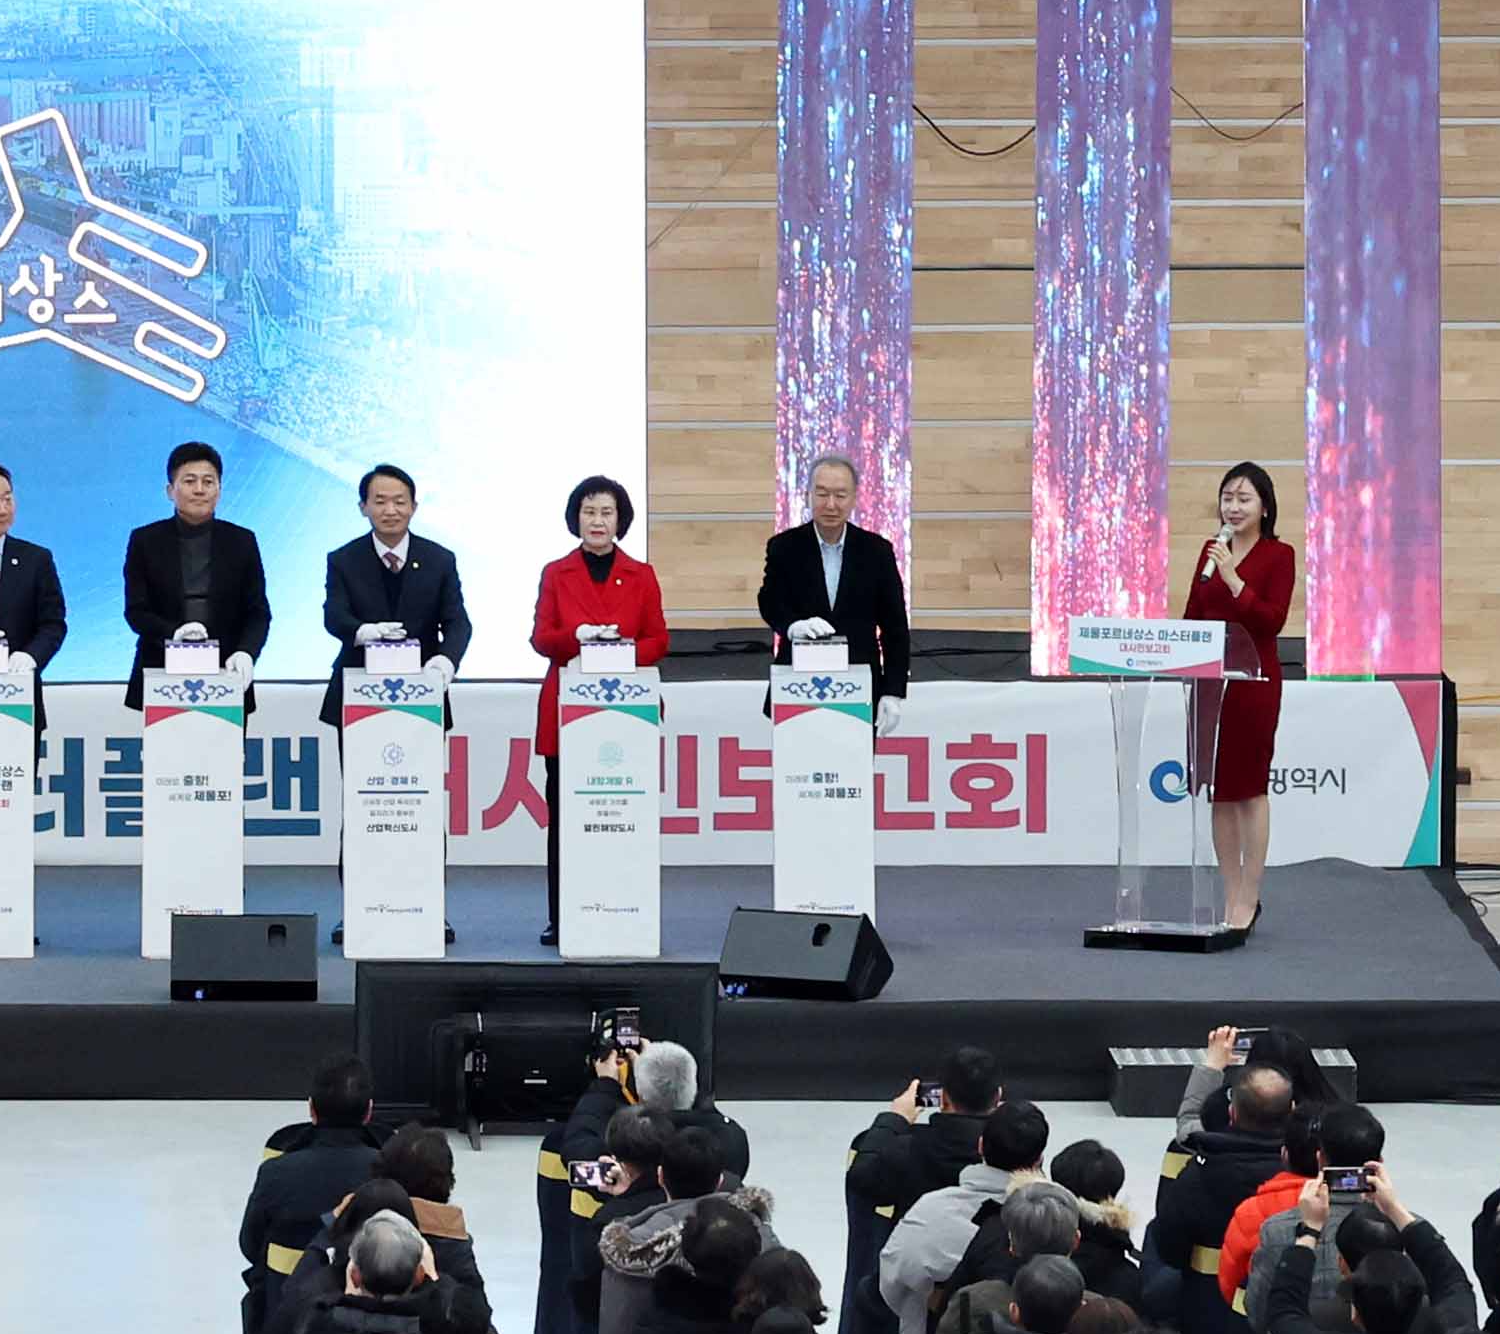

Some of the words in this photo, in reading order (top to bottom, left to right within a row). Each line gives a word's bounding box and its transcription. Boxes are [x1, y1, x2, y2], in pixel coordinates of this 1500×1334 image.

[1079, 626, 1155, 641] 제물포르네상스
[1157, 629, 1213, 644] 마스터플랜
[1119, 642, 1171, 655] 대시민보고회
[1268, 767, 1347, 796] 광역시
[194, 790, 232, 802] 제물포!
[824, 787, 862, 799] 제물포!
[366, 823, 419, 833] 산업혁신도시
